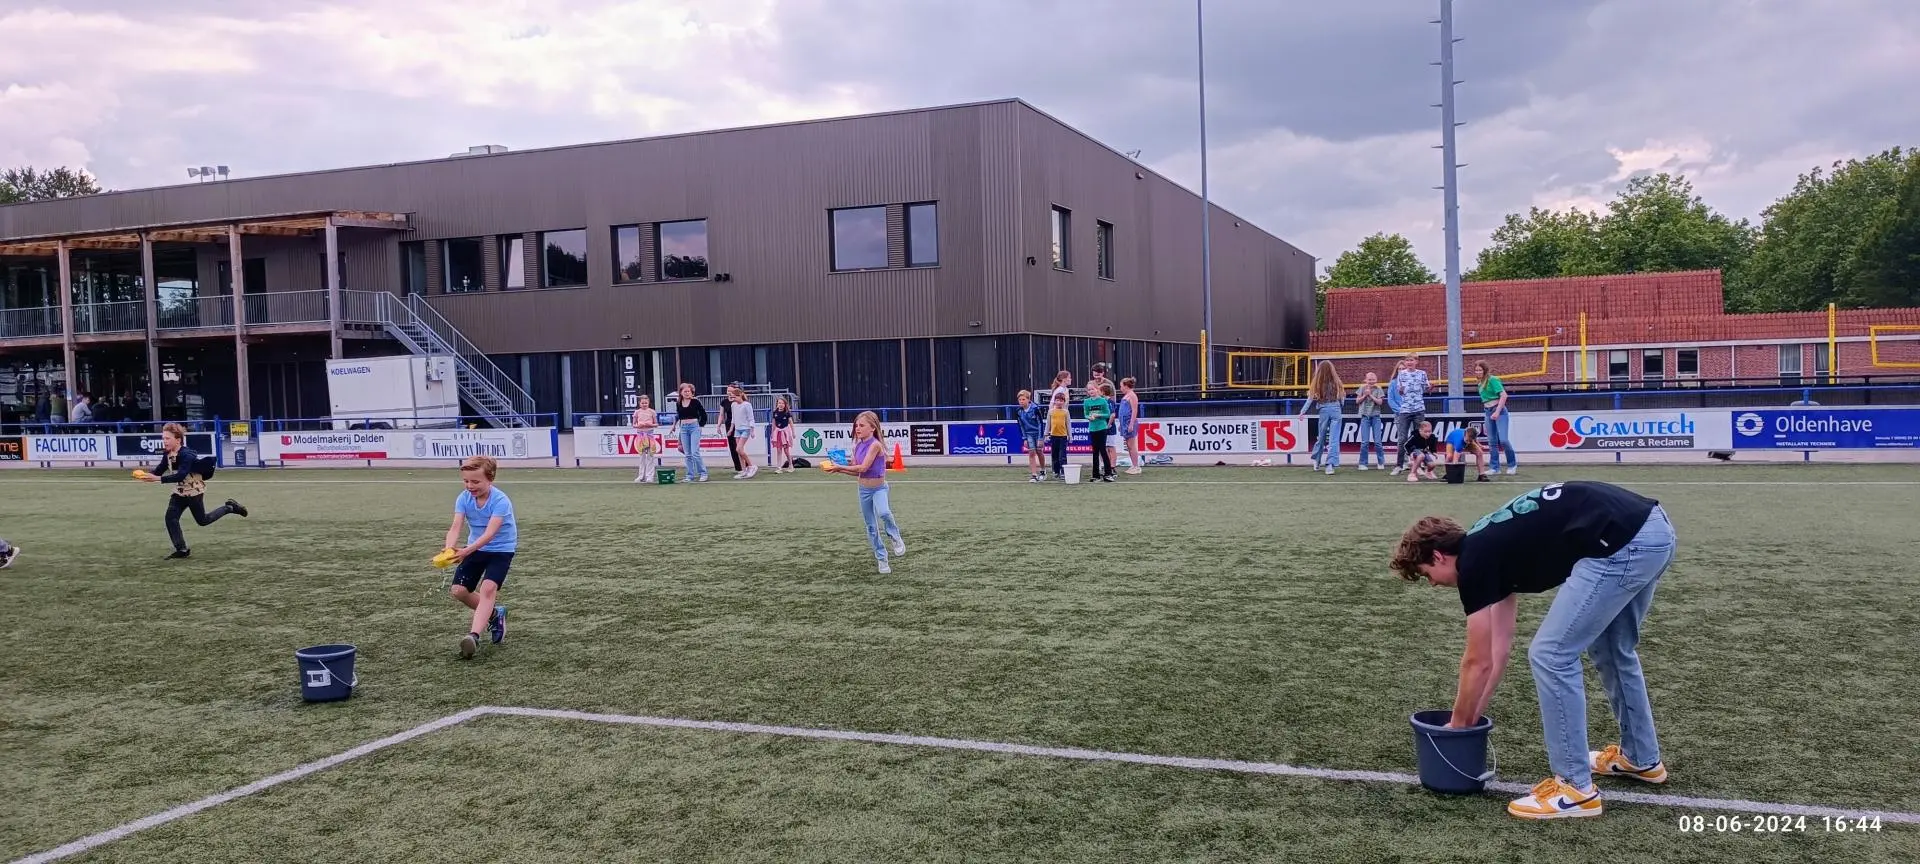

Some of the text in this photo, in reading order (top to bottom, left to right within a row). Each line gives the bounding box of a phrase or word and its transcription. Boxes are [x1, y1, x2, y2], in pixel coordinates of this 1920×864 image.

[625, 356, 633, 370] 8
[331, 367, 371, 375] KOELWAGEN
[625, 375, 635, 389] 9
[624, 394, 637, 408] 10
[1167, 422, 1249, 435] THEO SONDER
[1776, 415, 1873, 433] Oldenhave
[293, 435, 352, 445] Modelmakerij
[354, 434, 385, 443] Delden
[824, 430, 844, 439] TEN
[975, 435, 991, 445] ten
[1137, 423, 1165, 451] TS
[1261, 421, 1296, 450] TS
[35, 437, 98, 453] FACILITOR
[985, 443, 1008, 454] dam
[1189, 438, 1233, 451] AUTO'S
[1597, 437, 1690, 448] Graveer & Reclame
[432, 442, 507, 457] WAPEN VAN DELDEN
